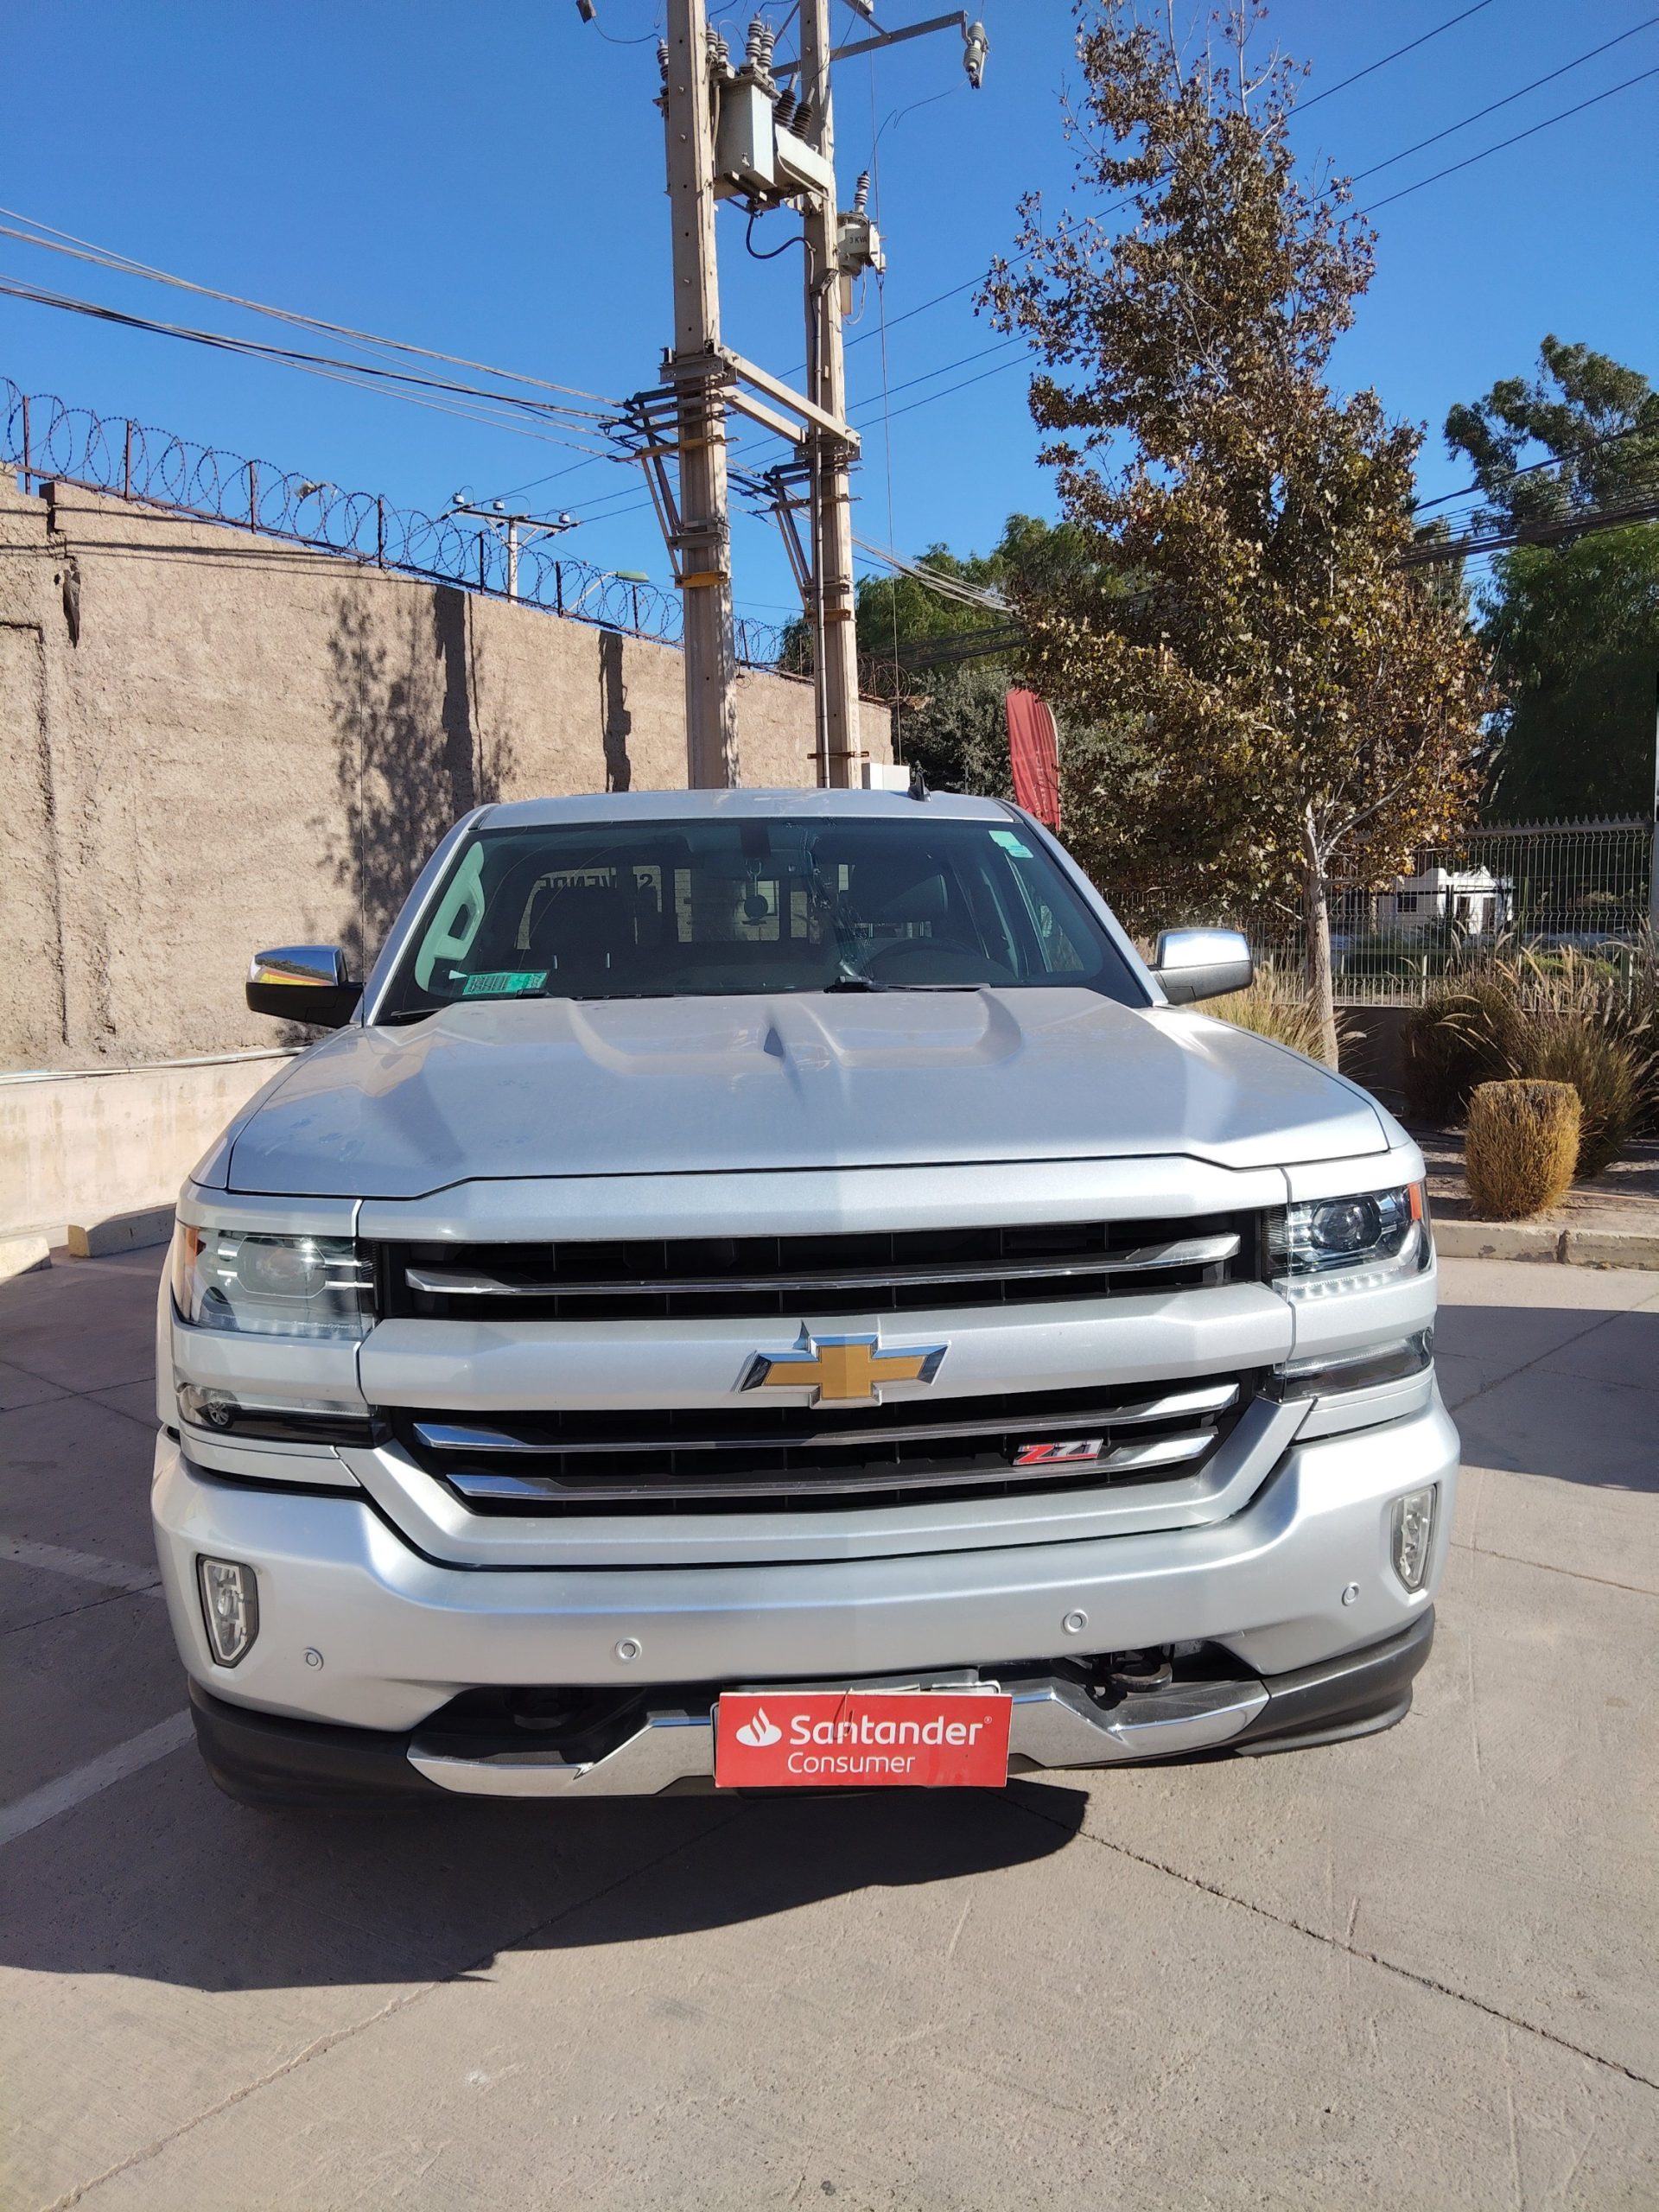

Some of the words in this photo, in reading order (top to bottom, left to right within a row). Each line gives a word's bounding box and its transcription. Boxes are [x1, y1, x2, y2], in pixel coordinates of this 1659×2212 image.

[1012, 1438, 1104, 1466] Z71
[789, 1714, 984, 1746] Santander
[787, 1751, 916, 1774] Consumer
